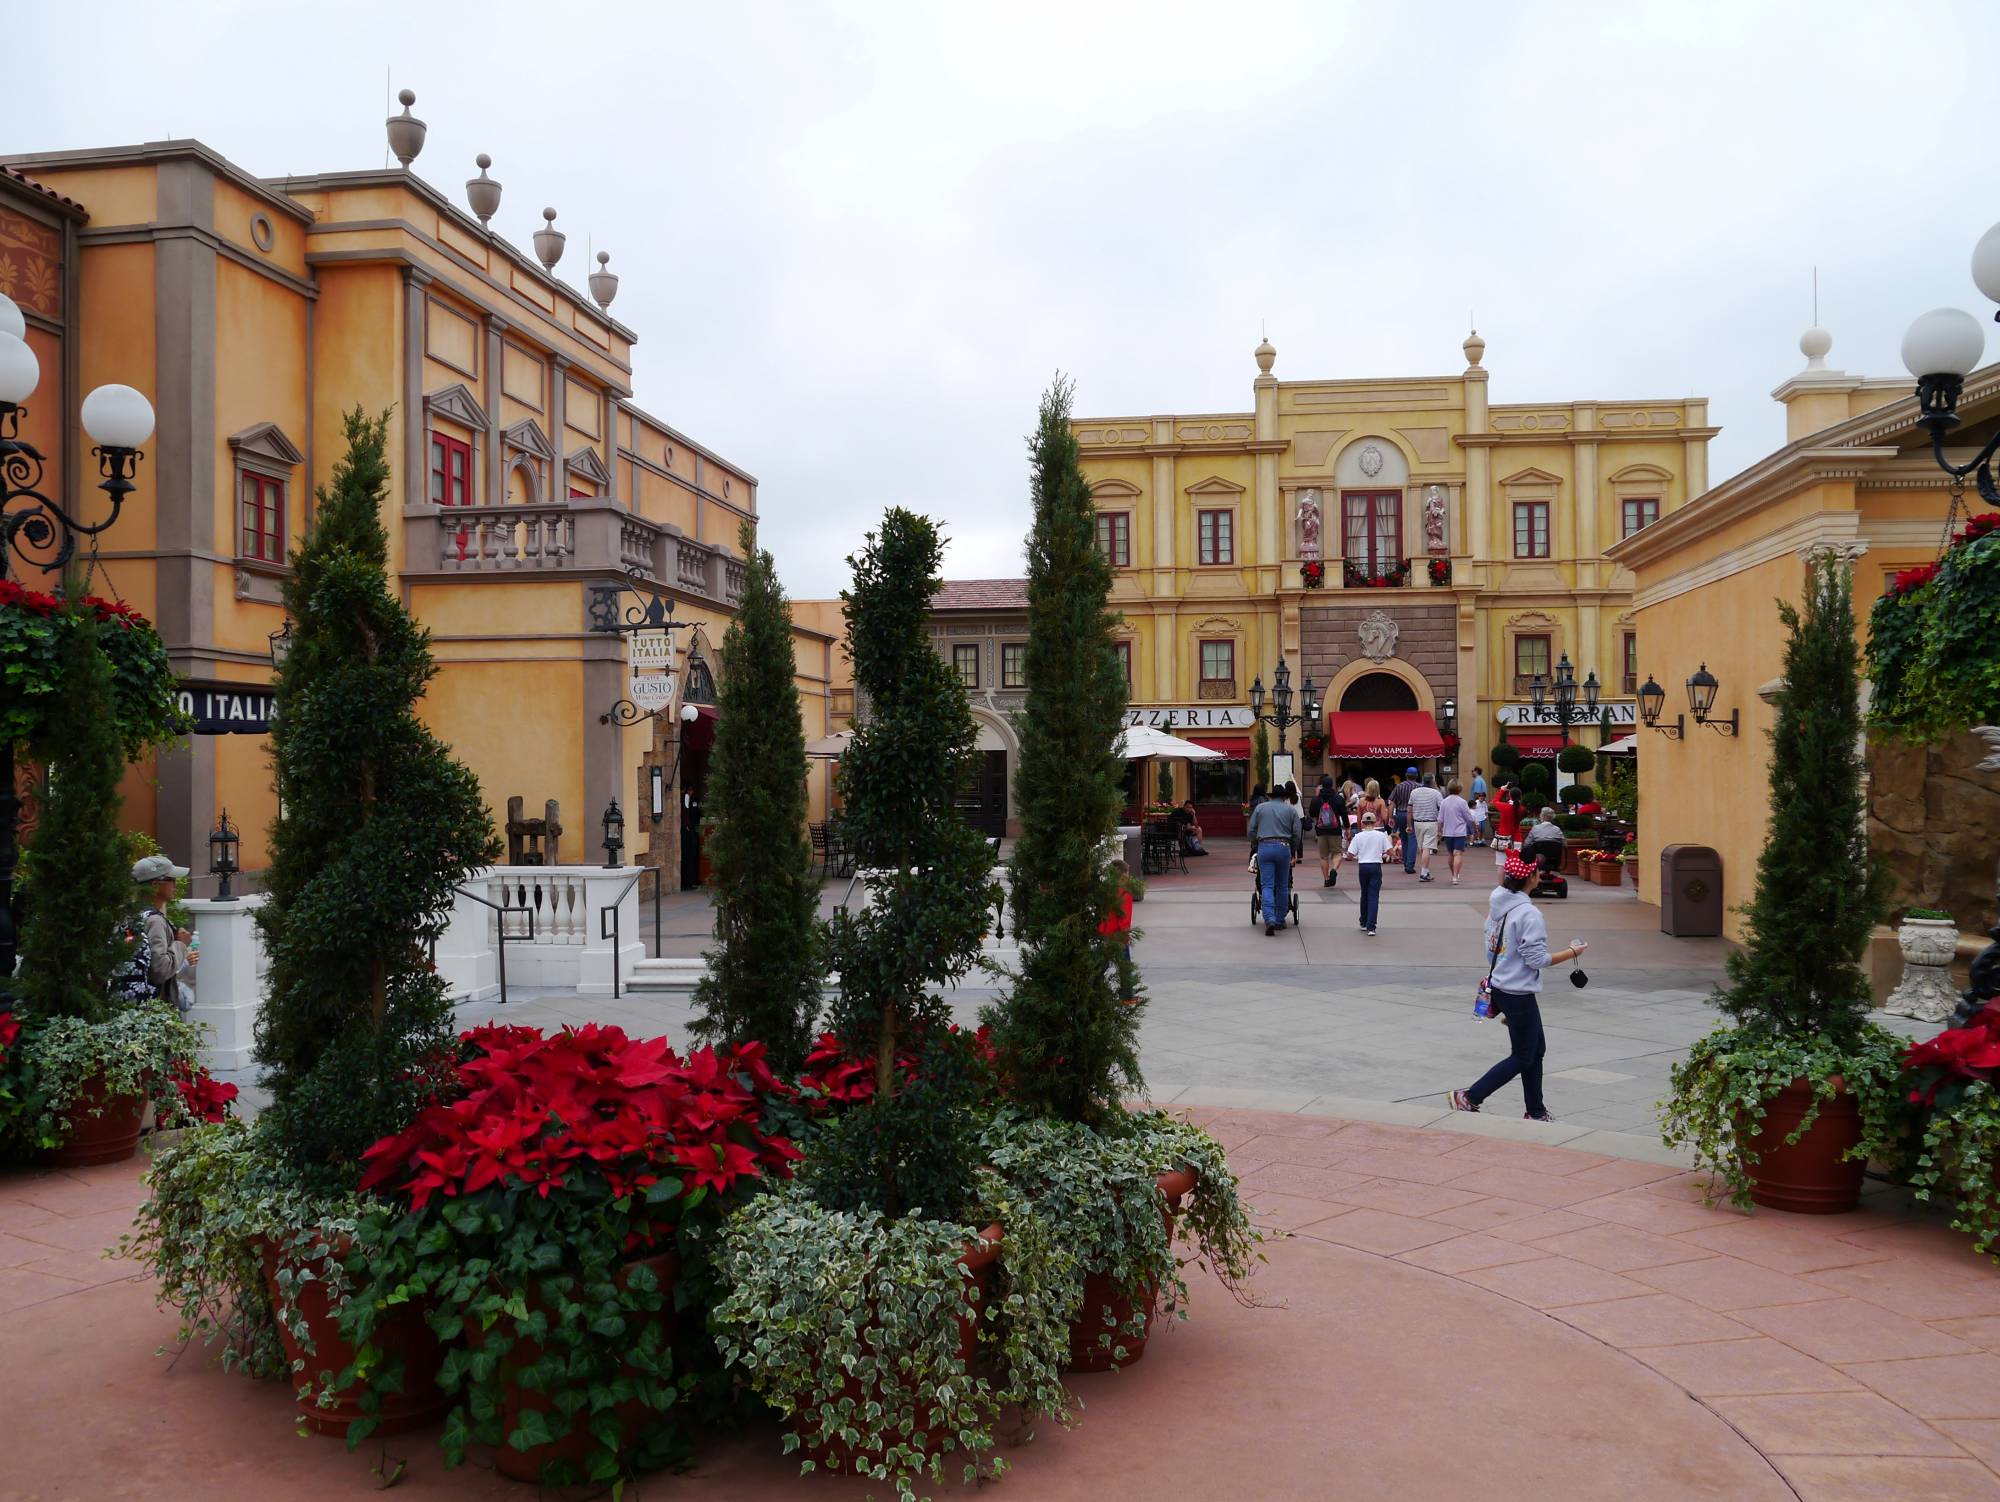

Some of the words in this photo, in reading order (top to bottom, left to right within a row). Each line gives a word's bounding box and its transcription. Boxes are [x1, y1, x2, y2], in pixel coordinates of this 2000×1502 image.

[633, 638, 671, 648] TUTTO
[633, 648, 671, 657] ITALIA
[633, 682, 672, 694] GUSTO
[1518, 706, 1635, 723] RISORAN
